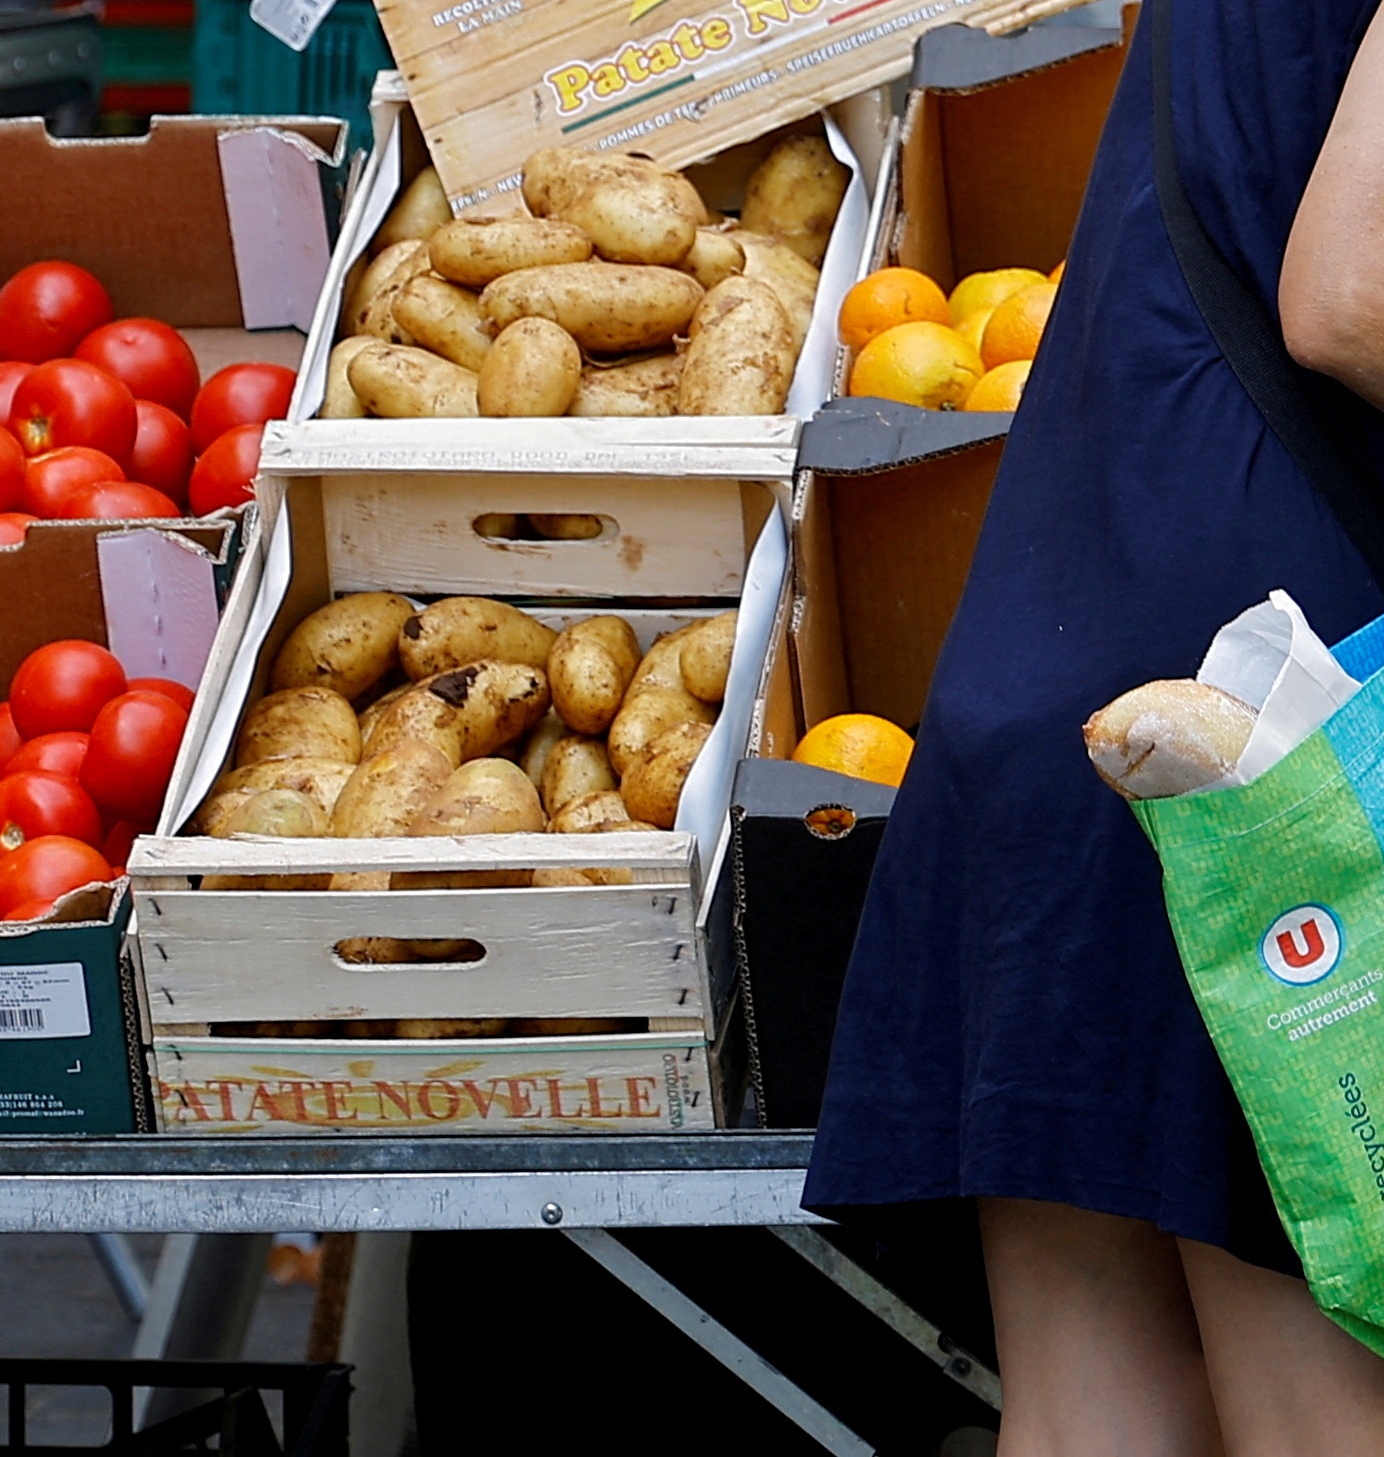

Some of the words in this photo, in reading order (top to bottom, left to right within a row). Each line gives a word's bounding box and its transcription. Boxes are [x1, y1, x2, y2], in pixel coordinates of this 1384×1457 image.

[457, 17, 479, 33] LA
[549, 15, 733, 112] Patate
[600, 122, 654, 150] POMMES
[653, 111, 674, 130] DE
[1276, 918, 1326, 968] U
[1266, 968, 1384, 1031] Commerçants
[1287, 990, 1378, 1042] autrement
[370, 1076, 663, 1122] NOVELLE
